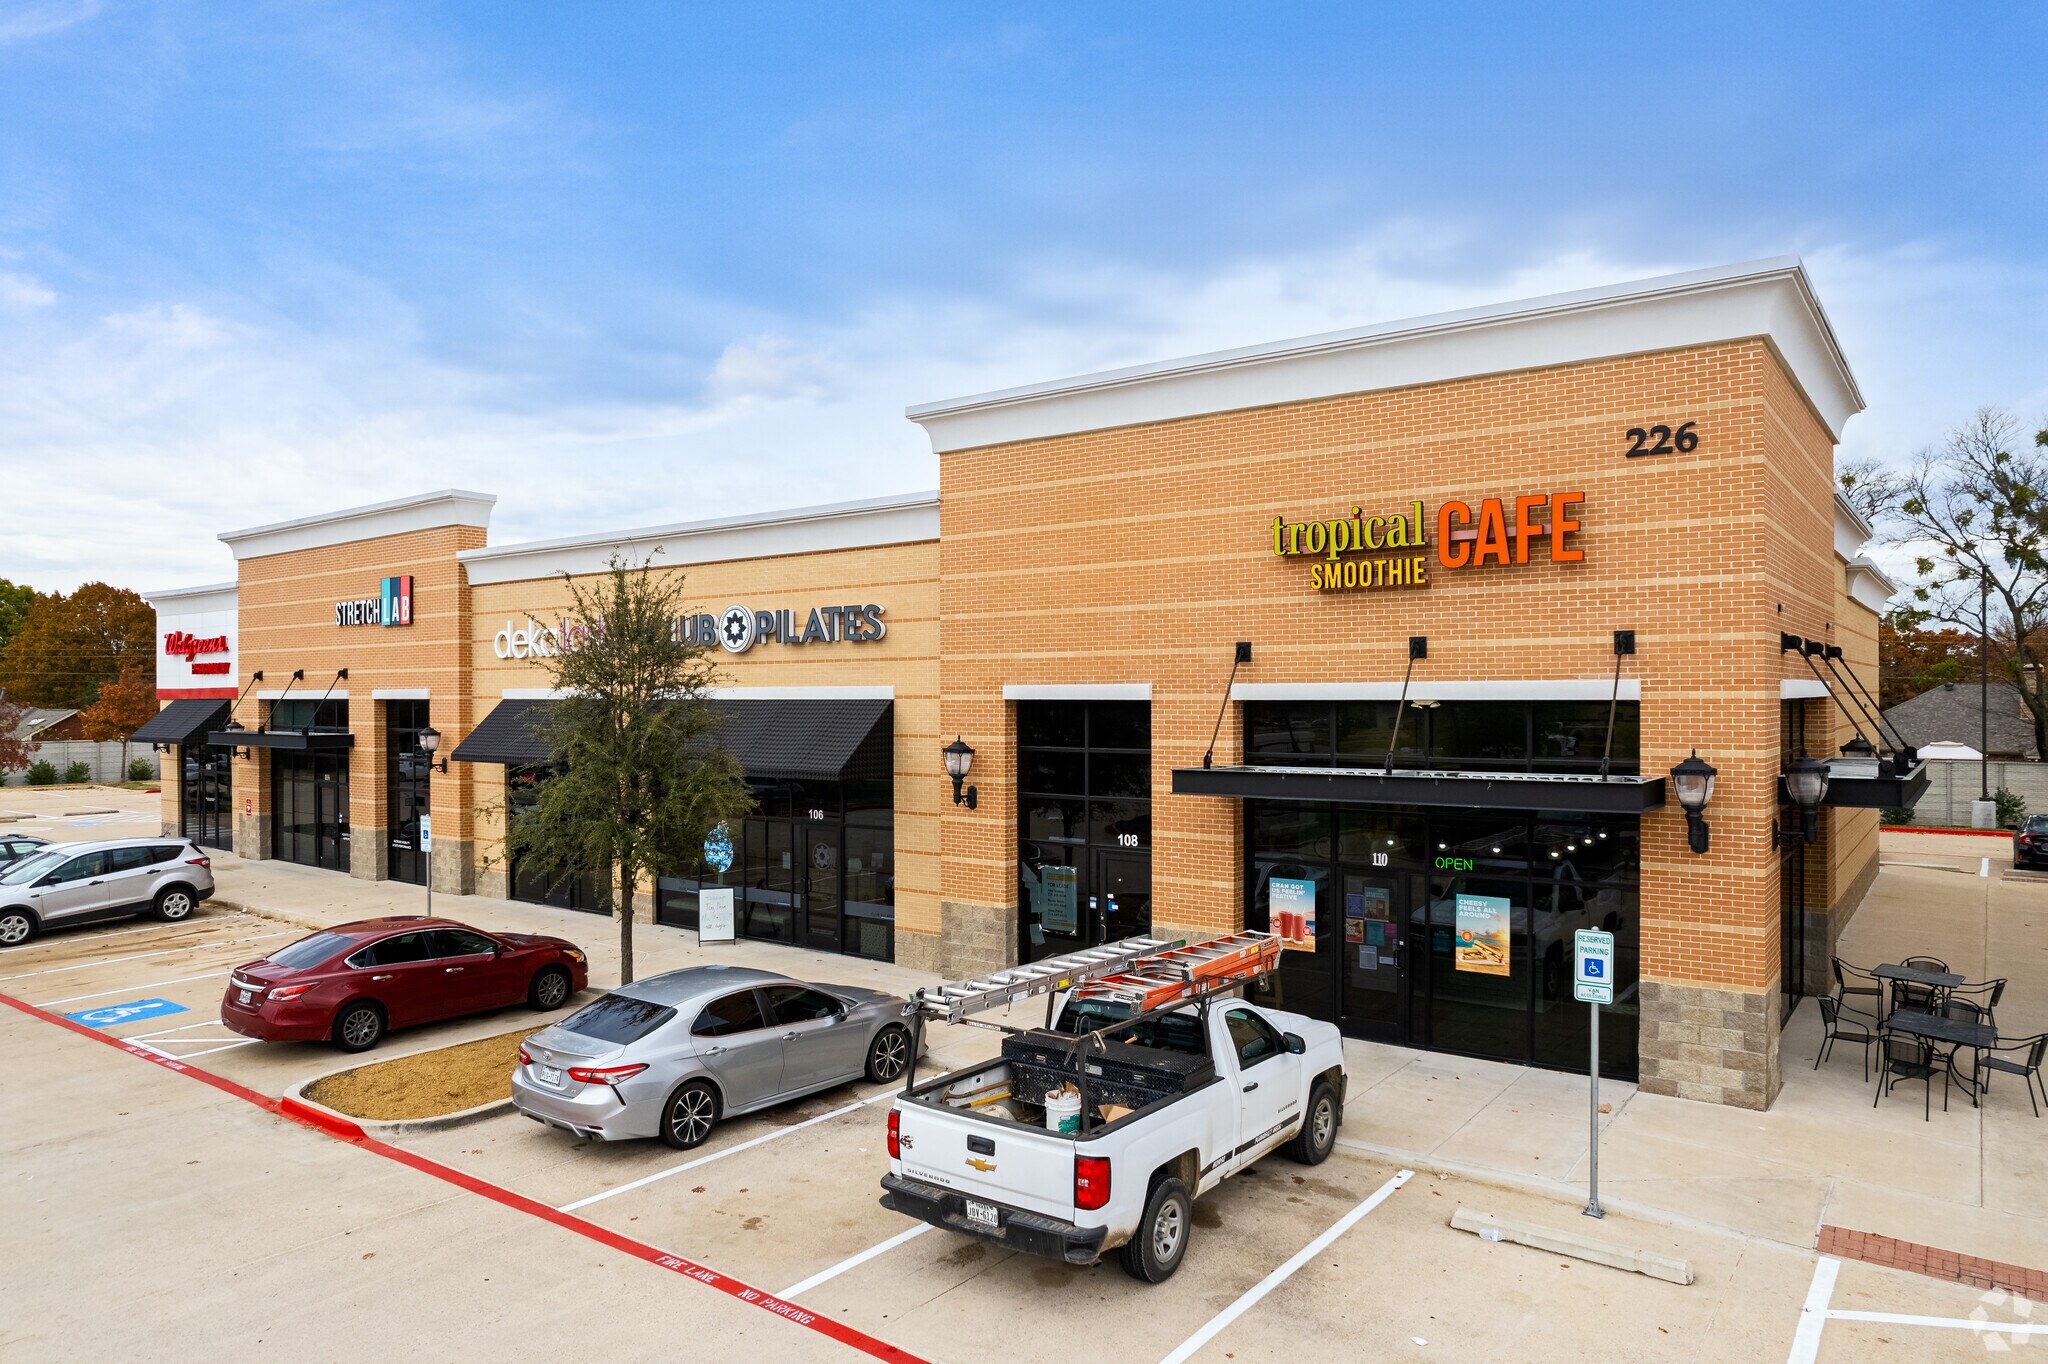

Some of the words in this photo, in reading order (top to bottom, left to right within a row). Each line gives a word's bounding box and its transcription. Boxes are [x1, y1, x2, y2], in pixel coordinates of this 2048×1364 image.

[1625, 421, 1699, 458] 226
[1271, 501, 1426, 561] tropical
[1438, 491, 1585, 570] CAFE
[1310, 557, 1427, 591] SMOOTHIE
[755, 603, 886, 645] PILATES
[808, 809, 824, 820] 106
[1117, 833, 1138, 847] 108
[1372, 852, 1388, 867] 110
[1435, 856, 1473, 871] OPEN
[1458, 899, 1488, 907] CHEESY
[1458, 904, 1483, 912] FEELS
[1458, 911, 1491, 919] AROUND
[1578, 935, 1611, 944] RESERVED
[1580, 946, 1609, 955] PARKING
[907, 1167, 951, 1184] SILVERADO
[655, 1255, 688, 1270] FIRE
[684, 1266, 721, 1284] LANE
[737, 1289, 761, 1301] NO
[758, 1298, 816, 1325] PARKING
